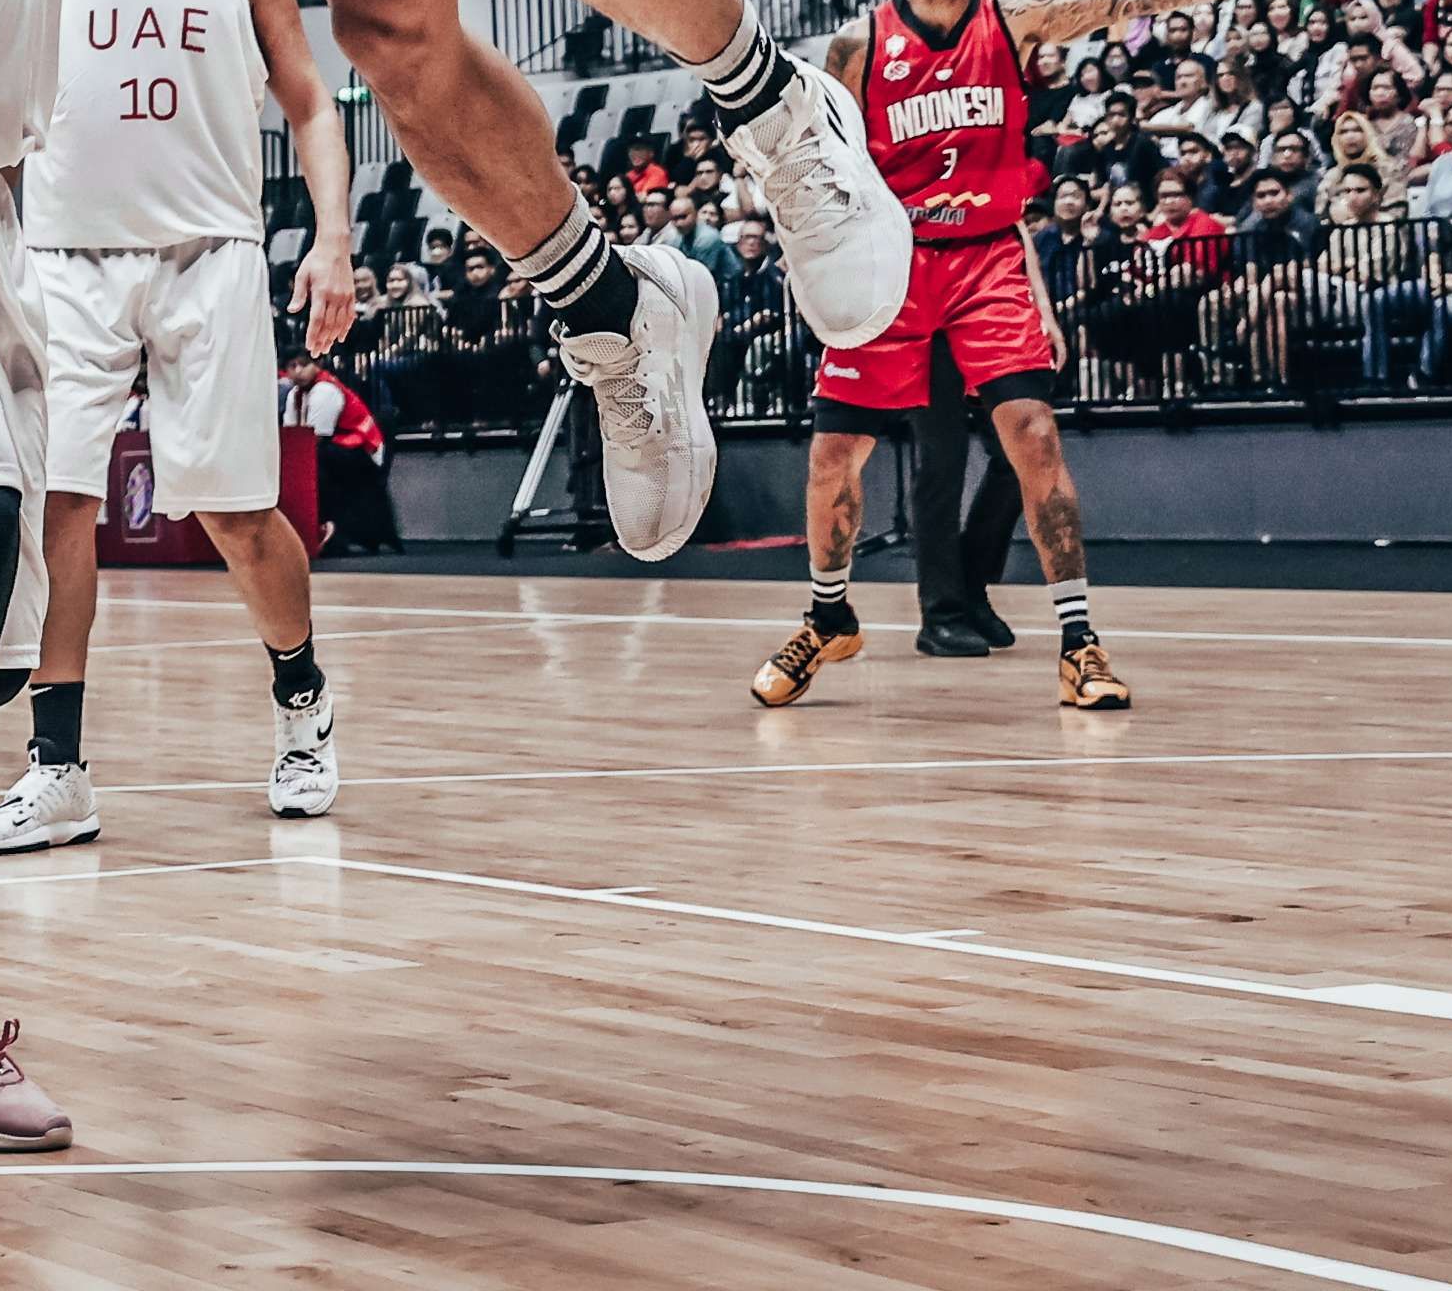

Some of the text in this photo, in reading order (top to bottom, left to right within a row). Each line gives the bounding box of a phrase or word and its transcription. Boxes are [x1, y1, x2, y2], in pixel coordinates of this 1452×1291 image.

[88, 6, 209, 54] UAE
[119, 77, 178, 122] 10
[886, 85, 1005, 145] INDONESIA
